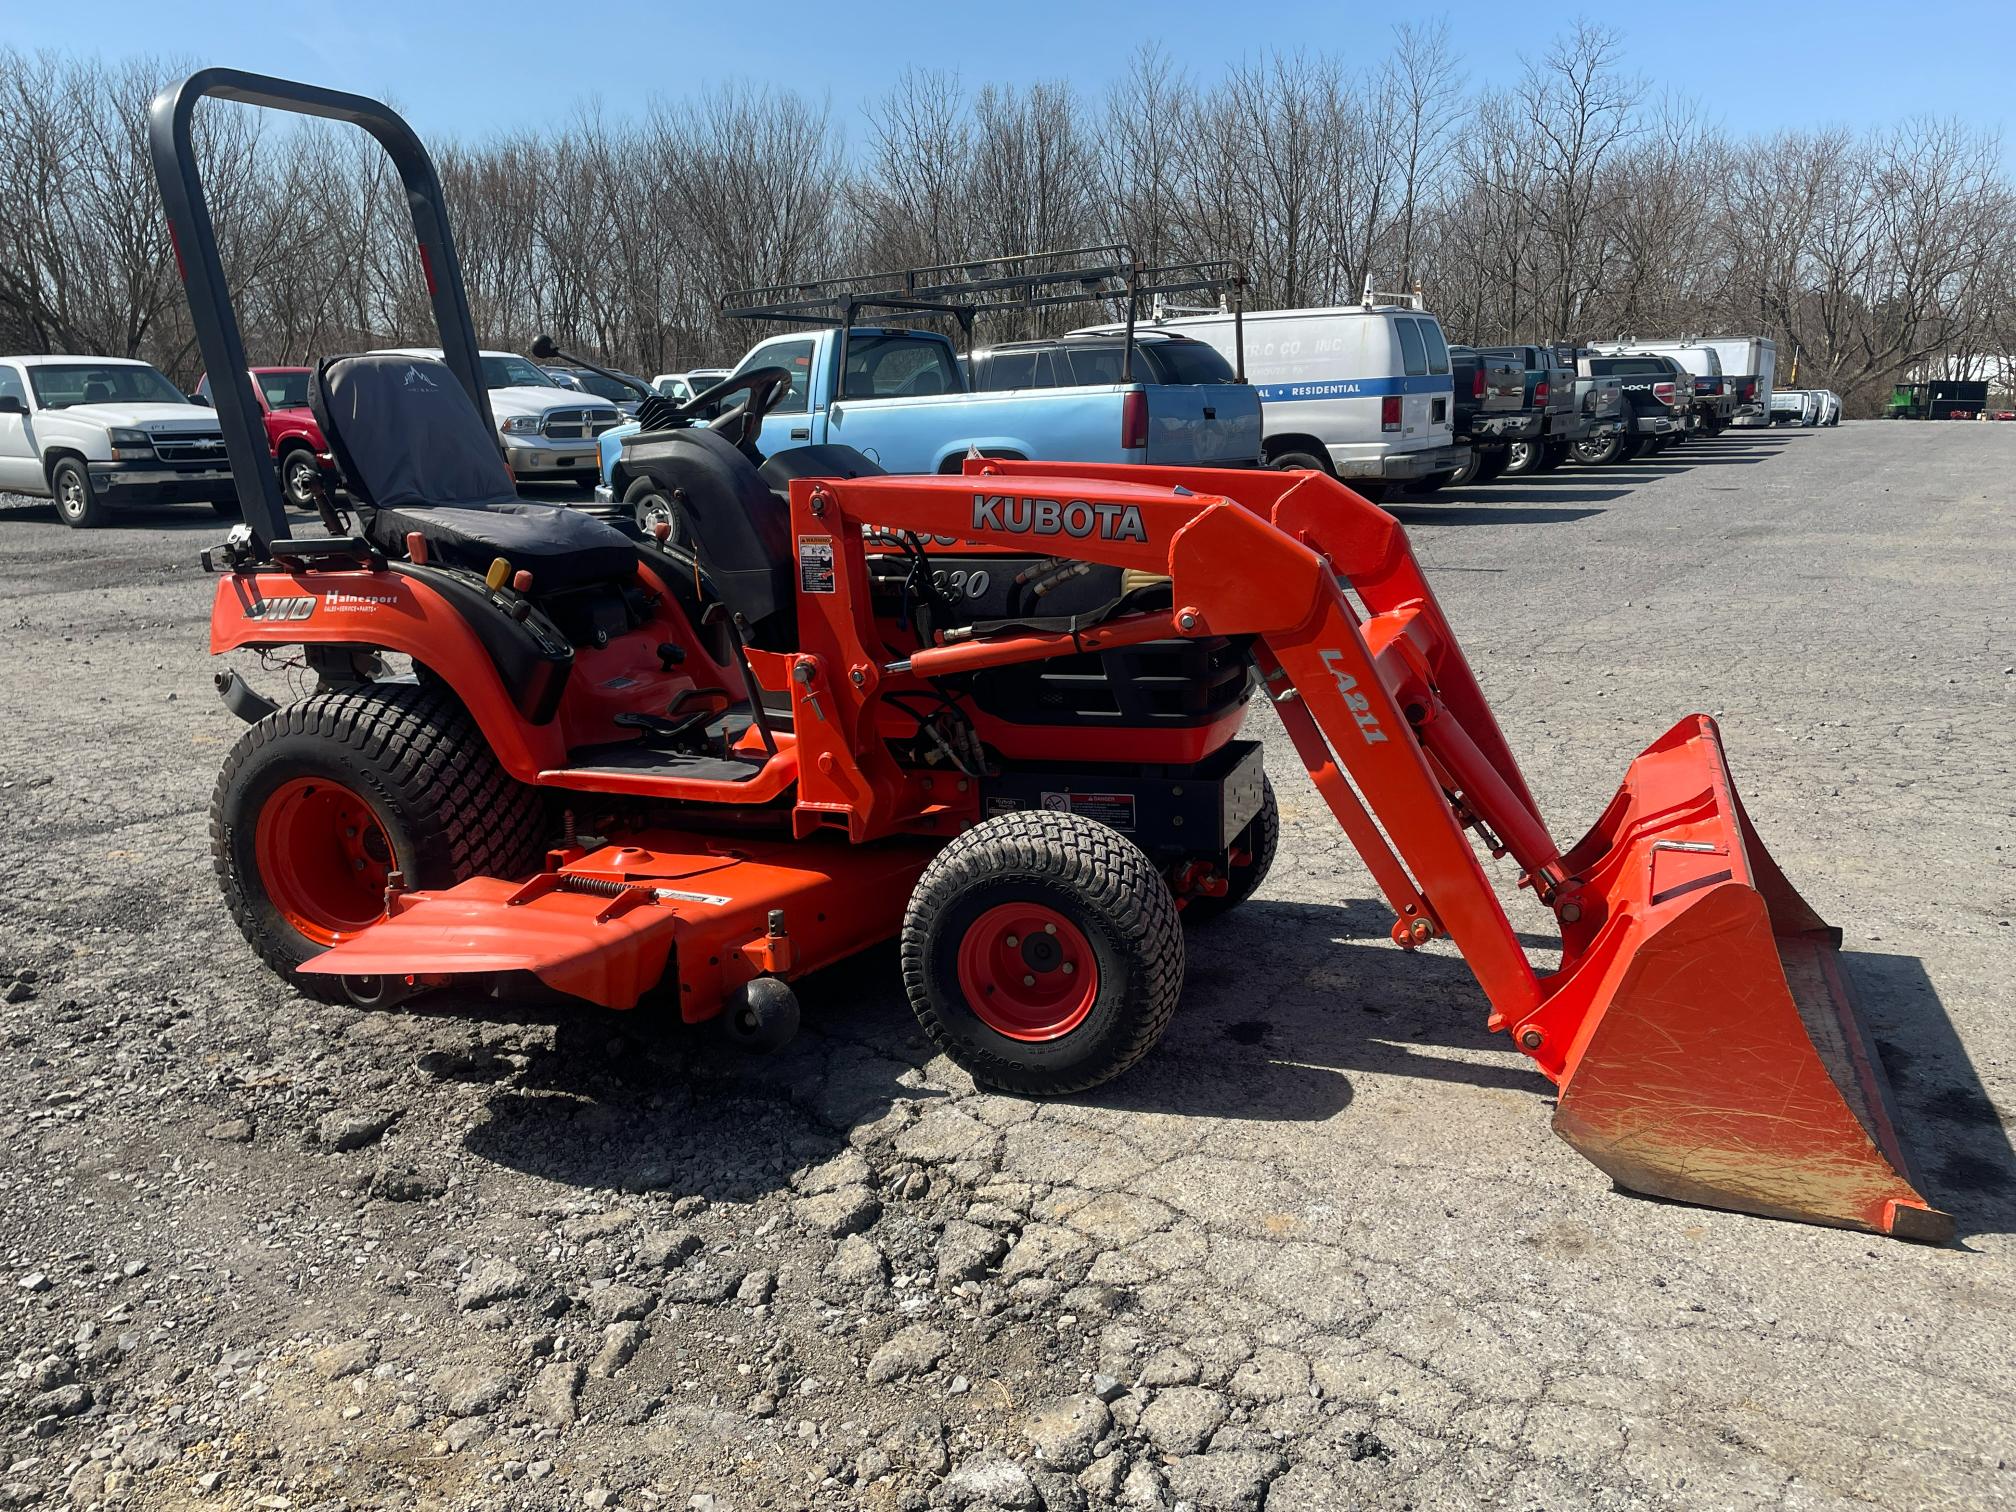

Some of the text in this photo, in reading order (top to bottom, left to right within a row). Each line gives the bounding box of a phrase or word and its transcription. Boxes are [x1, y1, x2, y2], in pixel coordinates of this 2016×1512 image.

[1314, 338, 1342, 353] INC
[1291, 384, 1361, 397] RESIDENTIAL
[972, 494, 1148, 542] KUBOTA
[325, 590, 398, 605] Hainesport
[1318, 648, 1389, 745] LA211
